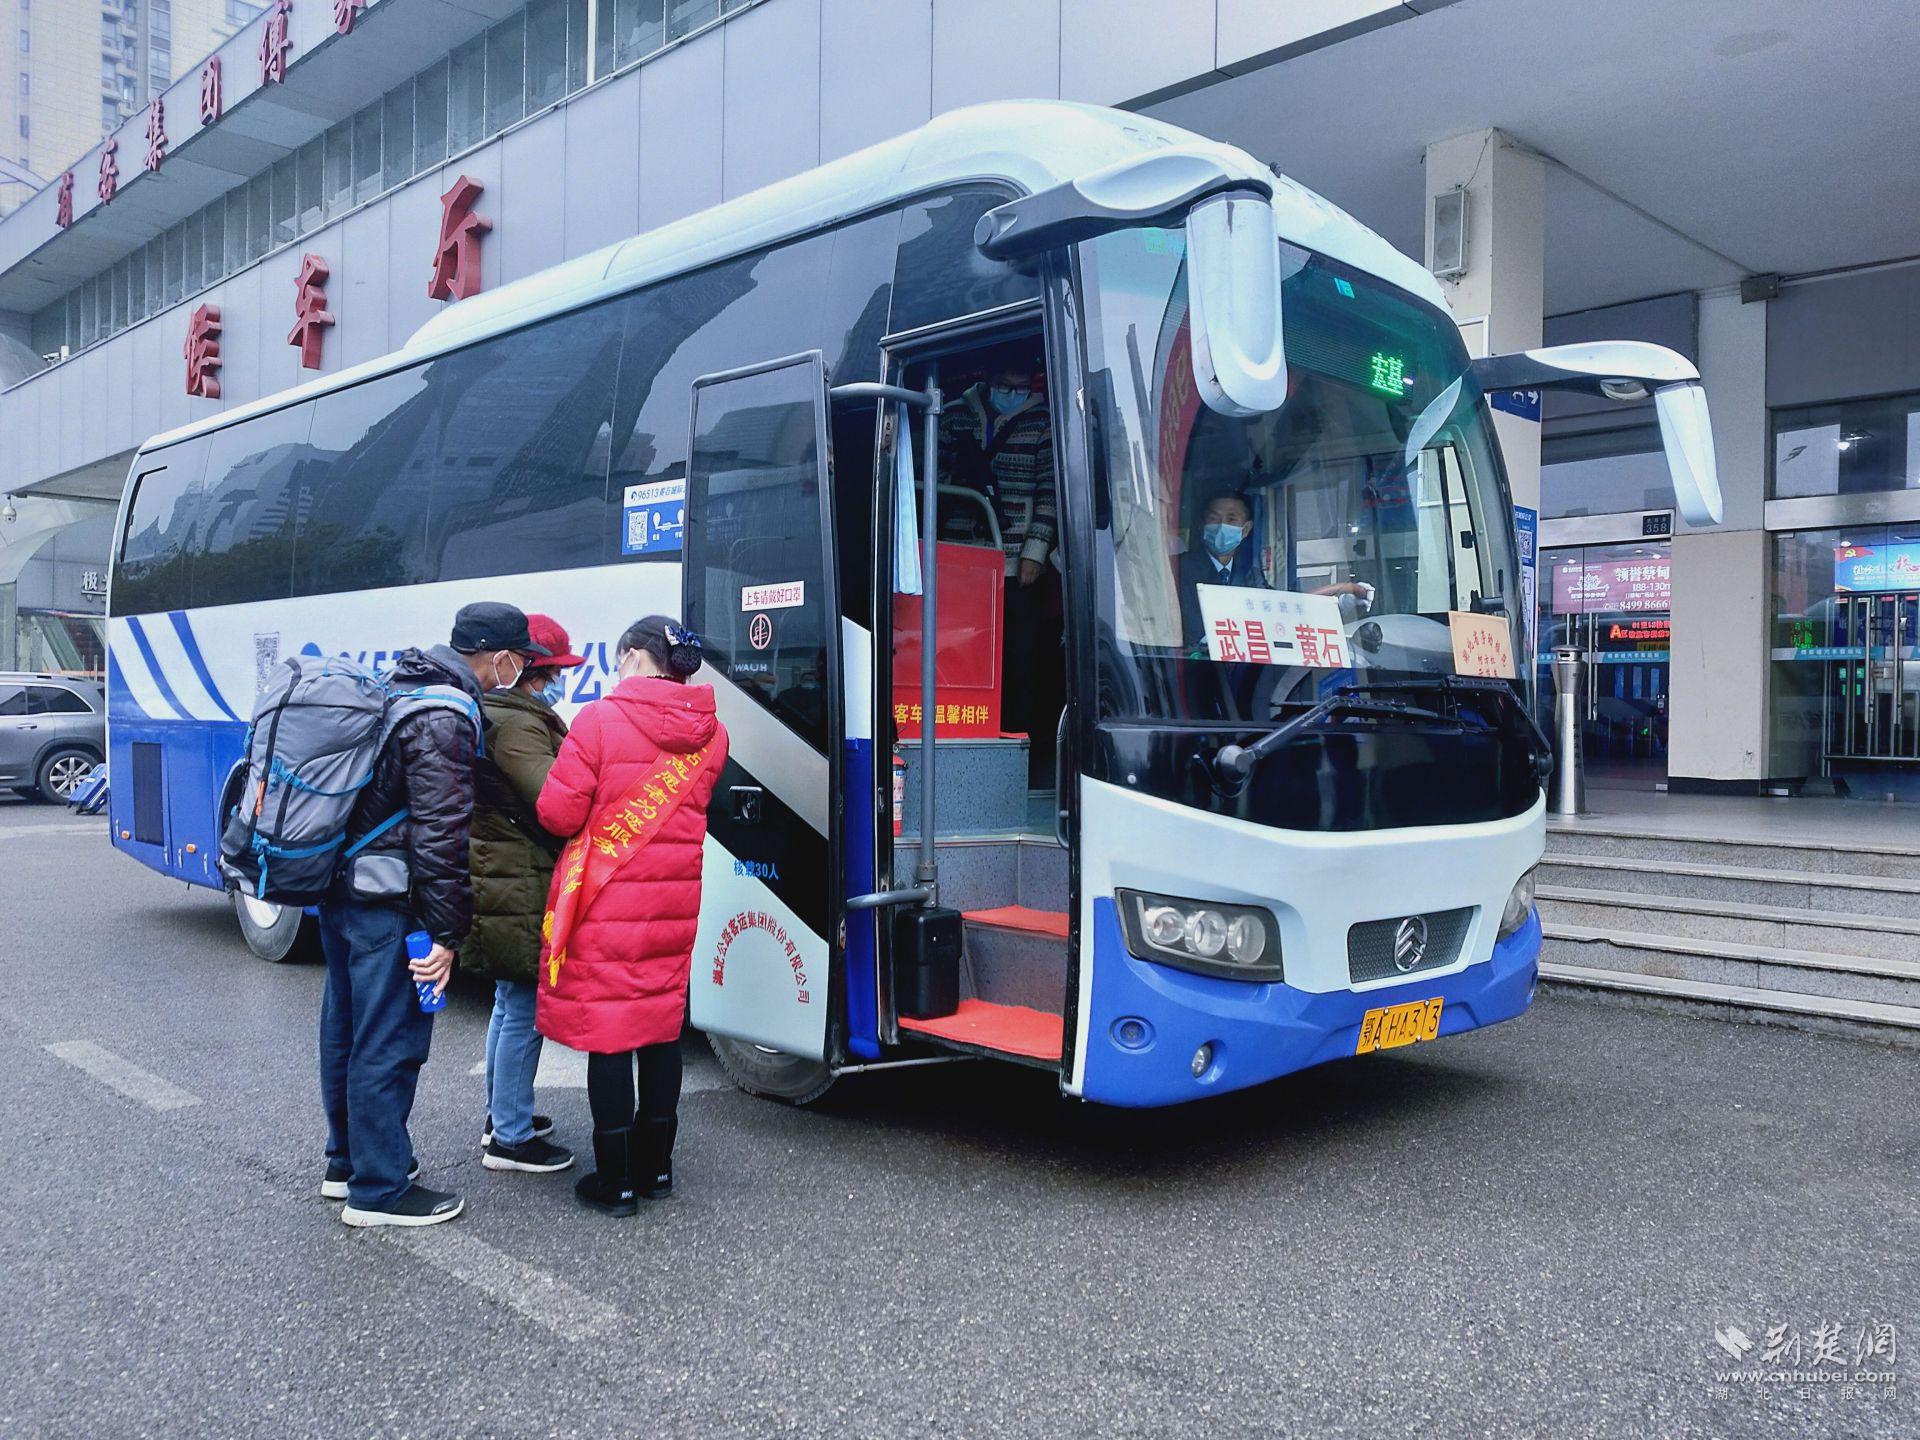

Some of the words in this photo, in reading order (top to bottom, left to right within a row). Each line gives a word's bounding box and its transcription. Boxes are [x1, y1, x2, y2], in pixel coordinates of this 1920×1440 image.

[184, 174, 493, 400] 候车厅
[1646, 523, 1667, 533] 358
[1619, 600, 1643, 610] 8499
[1644, 600, 1670, 609] 8666
[733, 859, 780, 881] 核载30人
[712, 911, 810, 1005] 湖北公路客运集团股份有限公司
